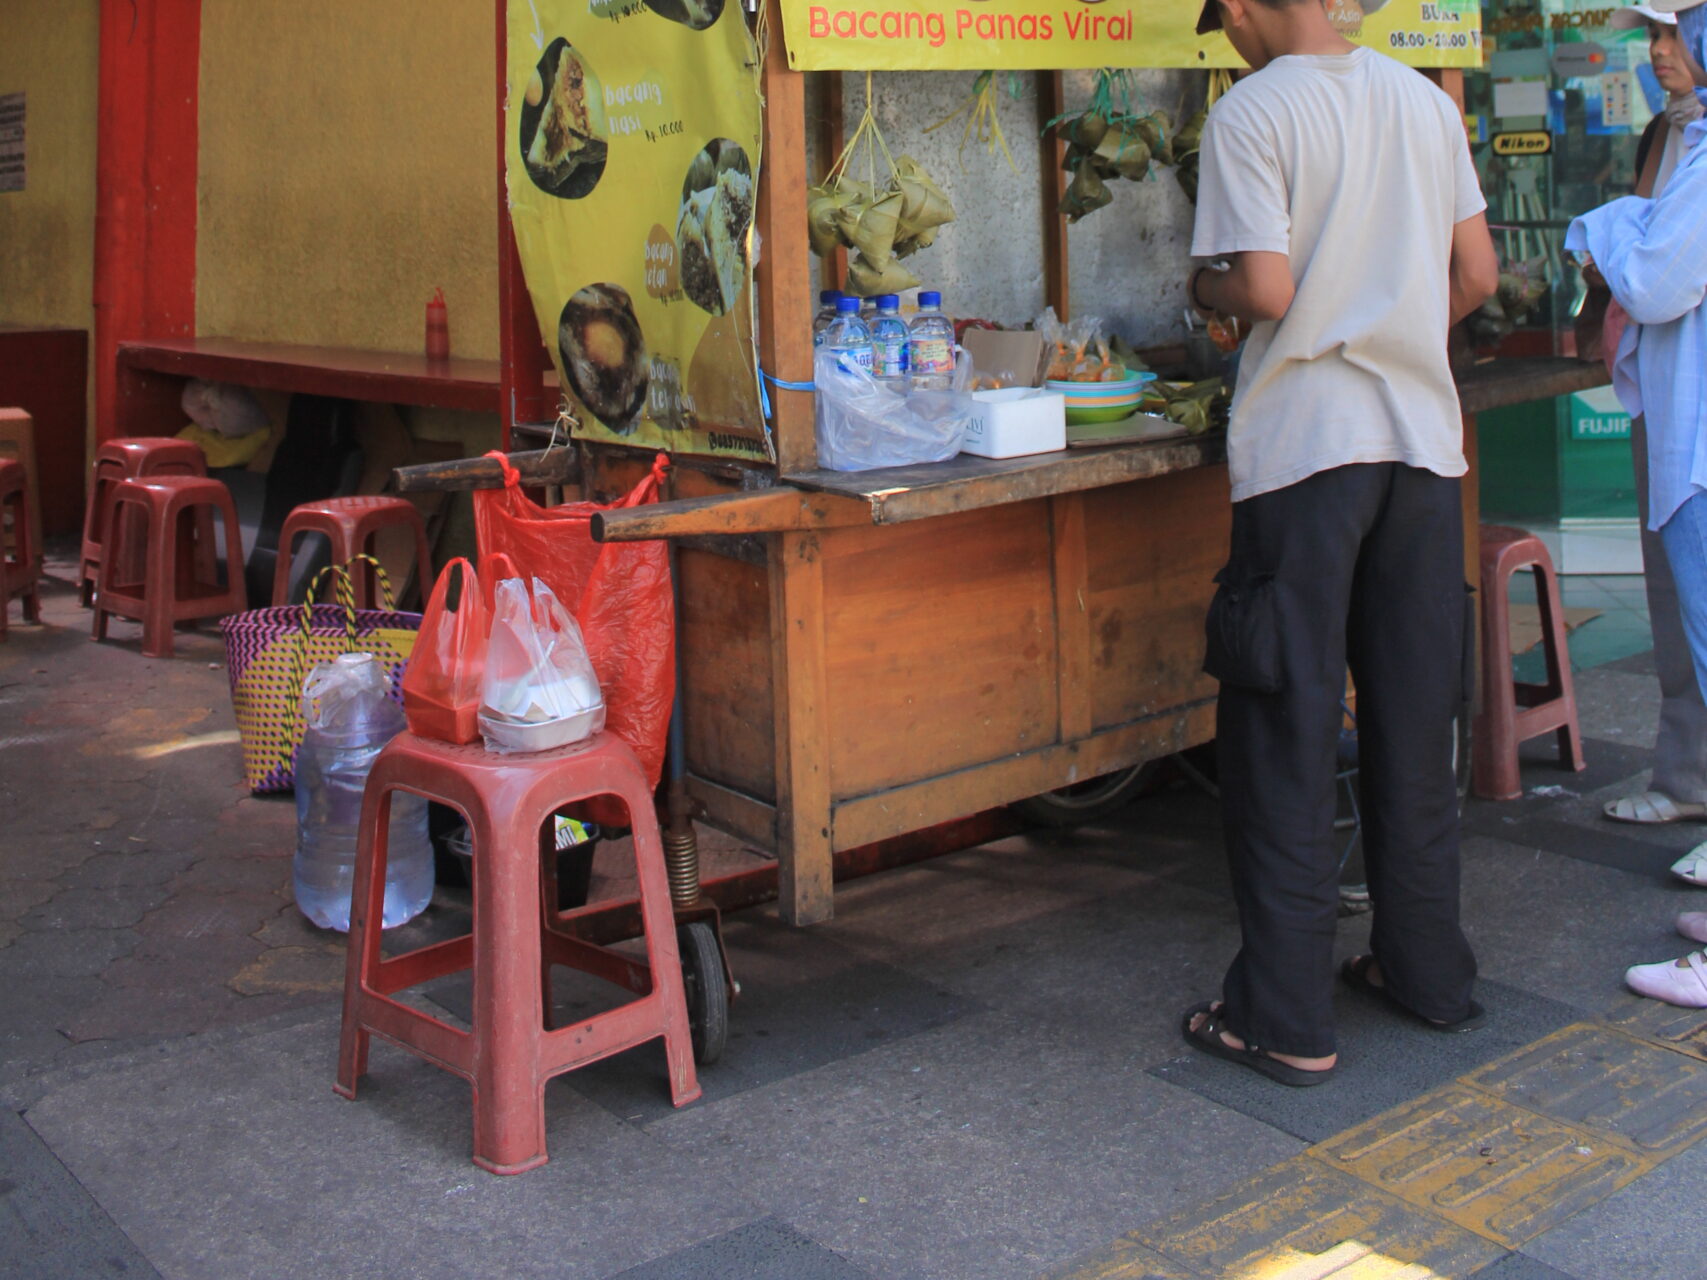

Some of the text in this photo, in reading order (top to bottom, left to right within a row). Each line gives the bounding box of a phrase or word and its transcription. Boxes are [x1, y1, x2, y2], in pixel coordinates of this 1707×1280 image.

[809, 6, 1132, 48] Bacang Panas Viral
[1389, 31, 1425, 48] 08.00
[1434, 32, 1467, 48] 2.00
[1500, 136, 1545, 150] Nikon
